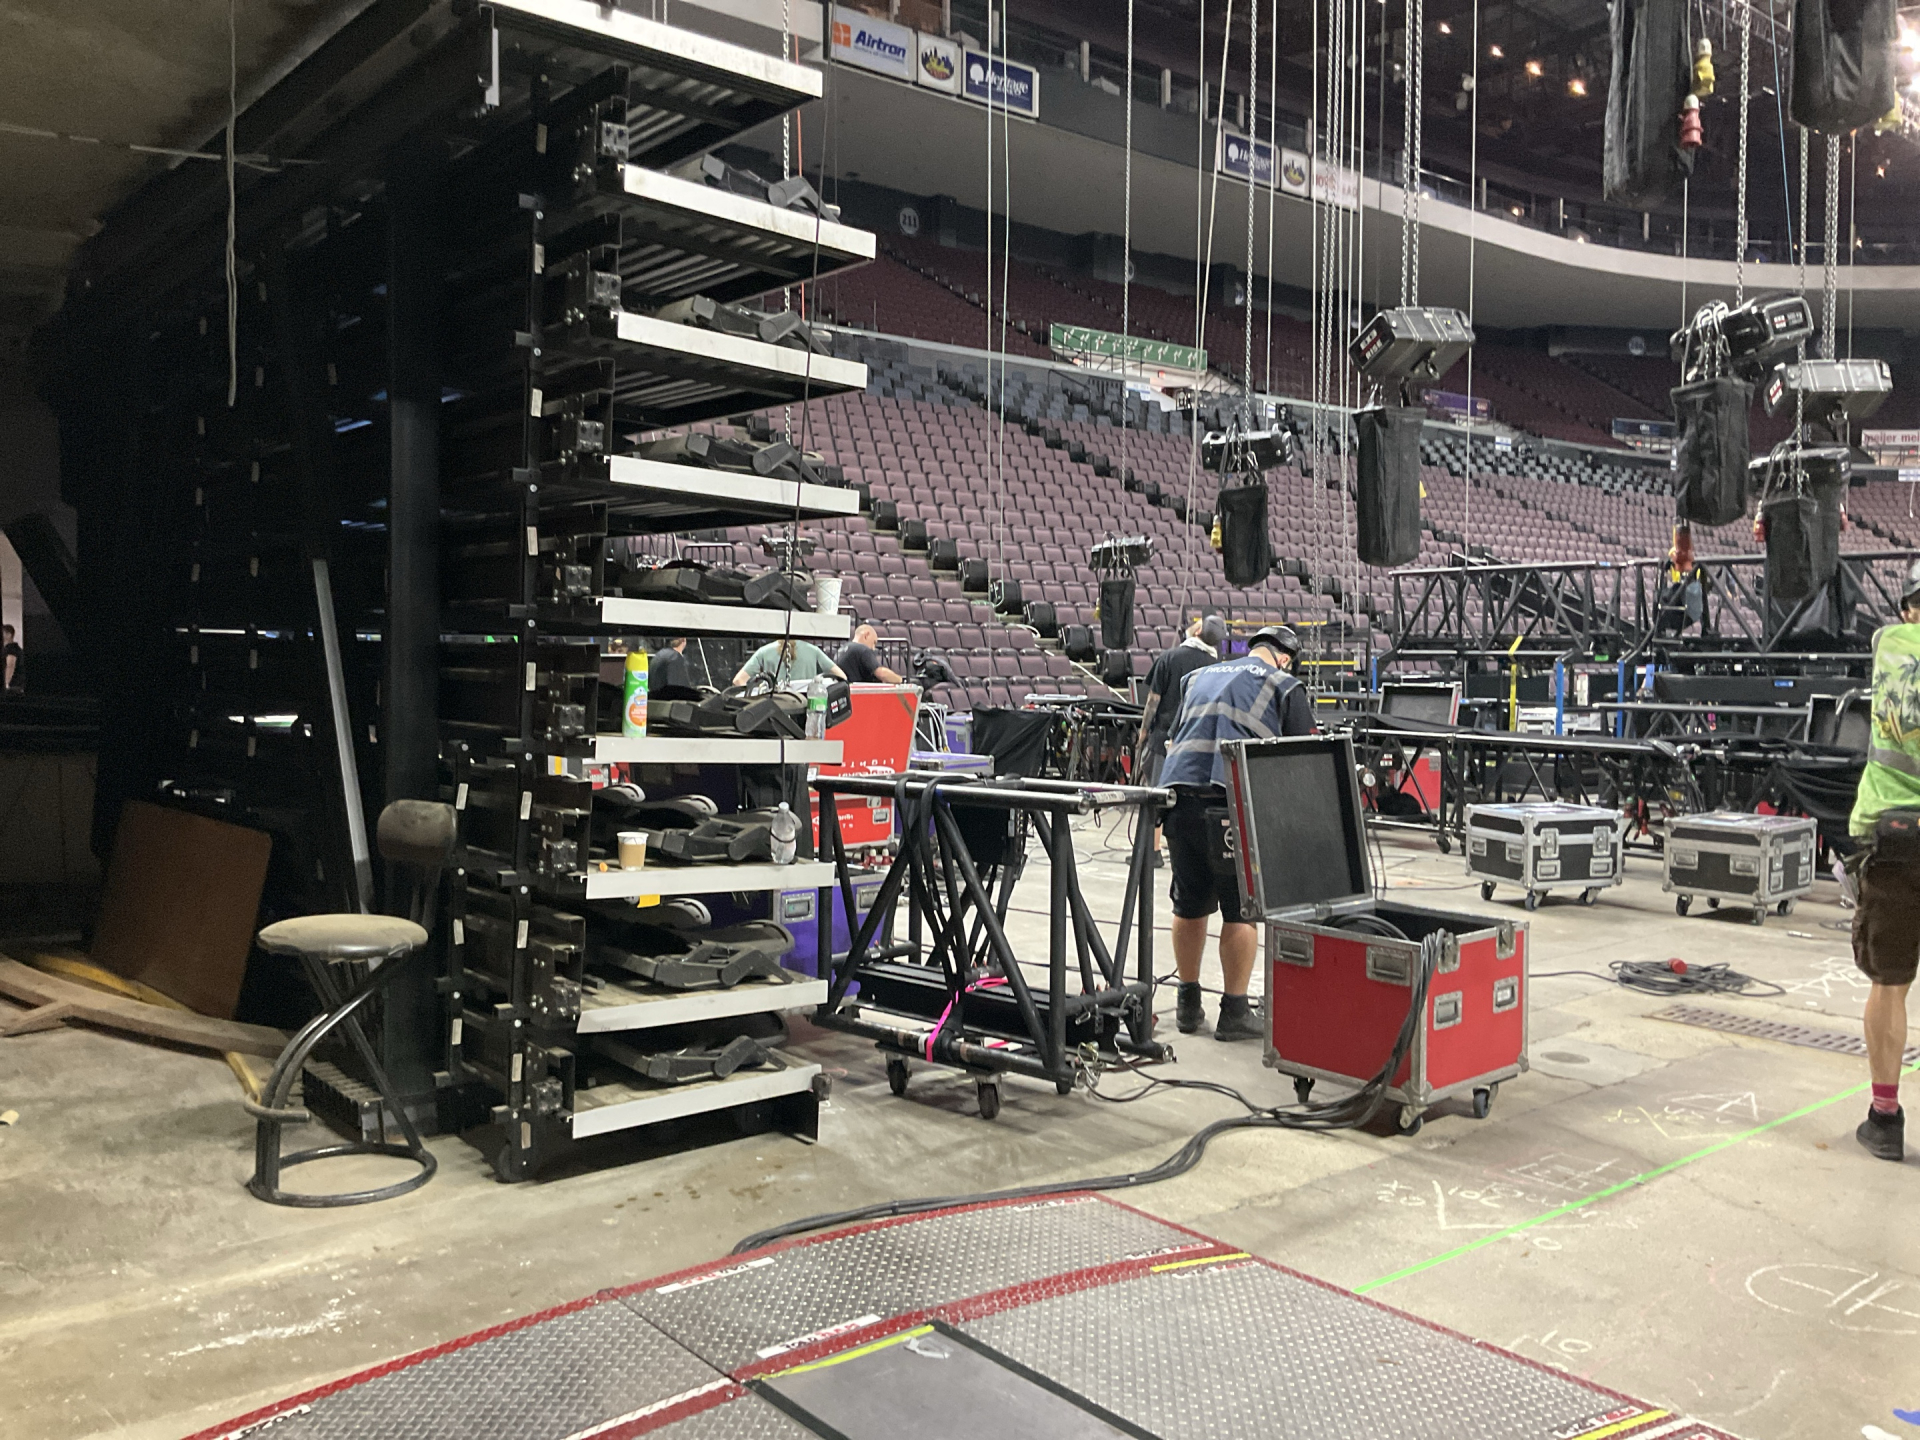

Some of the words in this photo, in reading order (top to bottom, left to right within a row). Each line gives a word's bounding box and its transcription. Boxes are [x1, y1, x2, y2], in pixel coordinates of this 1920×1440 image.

[855, 30, 906, 58] Airtron
[985, 69, 1029, 96] Hertage
[1204, 663, 1267, 676] PRODUCTION
